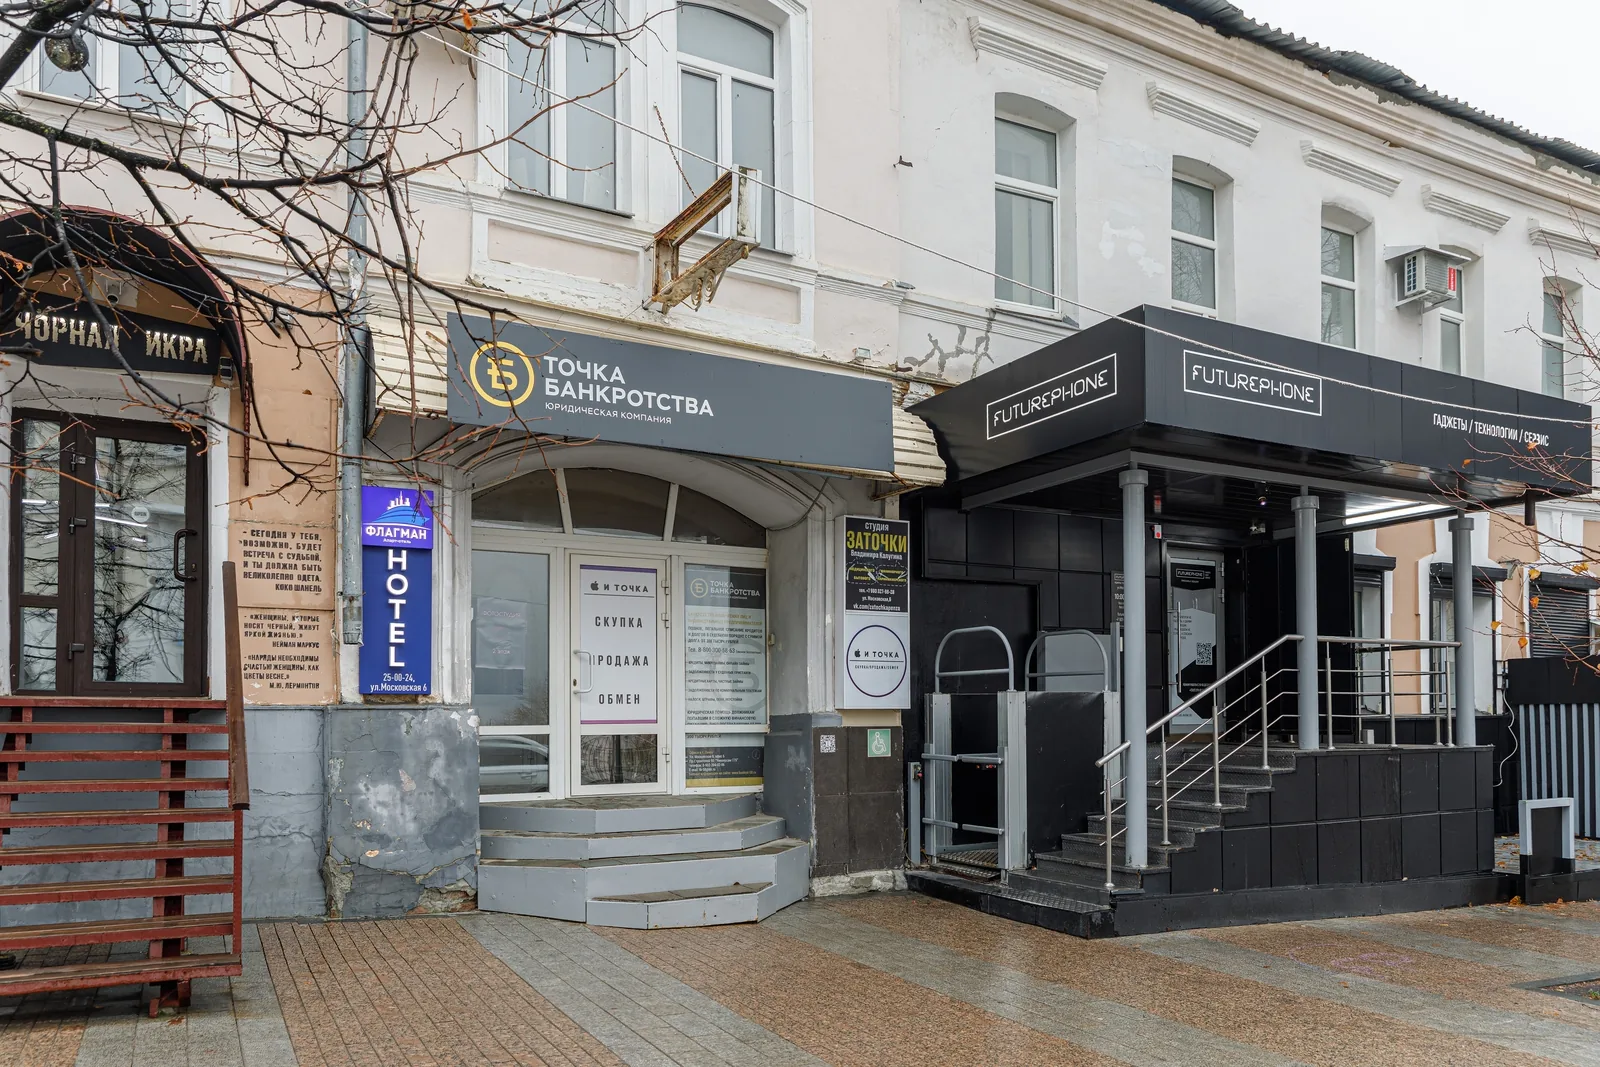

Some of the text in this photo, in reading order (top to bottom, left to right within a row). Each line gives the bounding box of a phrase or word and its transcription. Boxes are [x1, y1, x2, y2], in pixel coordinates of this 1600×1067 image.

[146, 330, 208, 364] ИКРА
[544, 356, 626, 384] ТОЧКА
[1193, 365, 1314, 403] FUTUREPHONE
[545, 378, 714, 416] БАНКРОТСТВА
[994, 370, 1108, 426] FUTUREPHONE
[546, 402, 672, 424] ЮРИДИЧЕСКАЯ КОМПАНИЯ
[1434, 414, 1468, 431] ГАДЖЕТЫ
[1474, 422, 1517, 440] ТЕХНОЛОГИИ
[250, 530, 287, 539] СЕГОДНЯ
[366, 526, 426, 540] ФЛАГМАН
[296, 543, 322, 551] БУДЕТ
[847, 531, 907, 552] ЗАТОЧКИ
[243, 550, 275, 559] ВСТРЕЧА
[851, 550, 902, 560] Владимира Калугина
[266, 562, 298, 570] ДОЛЖНА
[243, 572, 294, 580] ВЕЛИКОЛЕПНО
[614, 584, 648, 592] ТОЧКА
[710, 588, 760, 596] БАНКРОТСТВА
[386, 549, 408, 667] HOTEL
[595, 616, 643, 628] СКУПКА
[383, 673, 415, 682] 25-00-24,
[370, 683, 422, 692] ул.Московская
[599, 694, 640, 704] ОБМЕН
